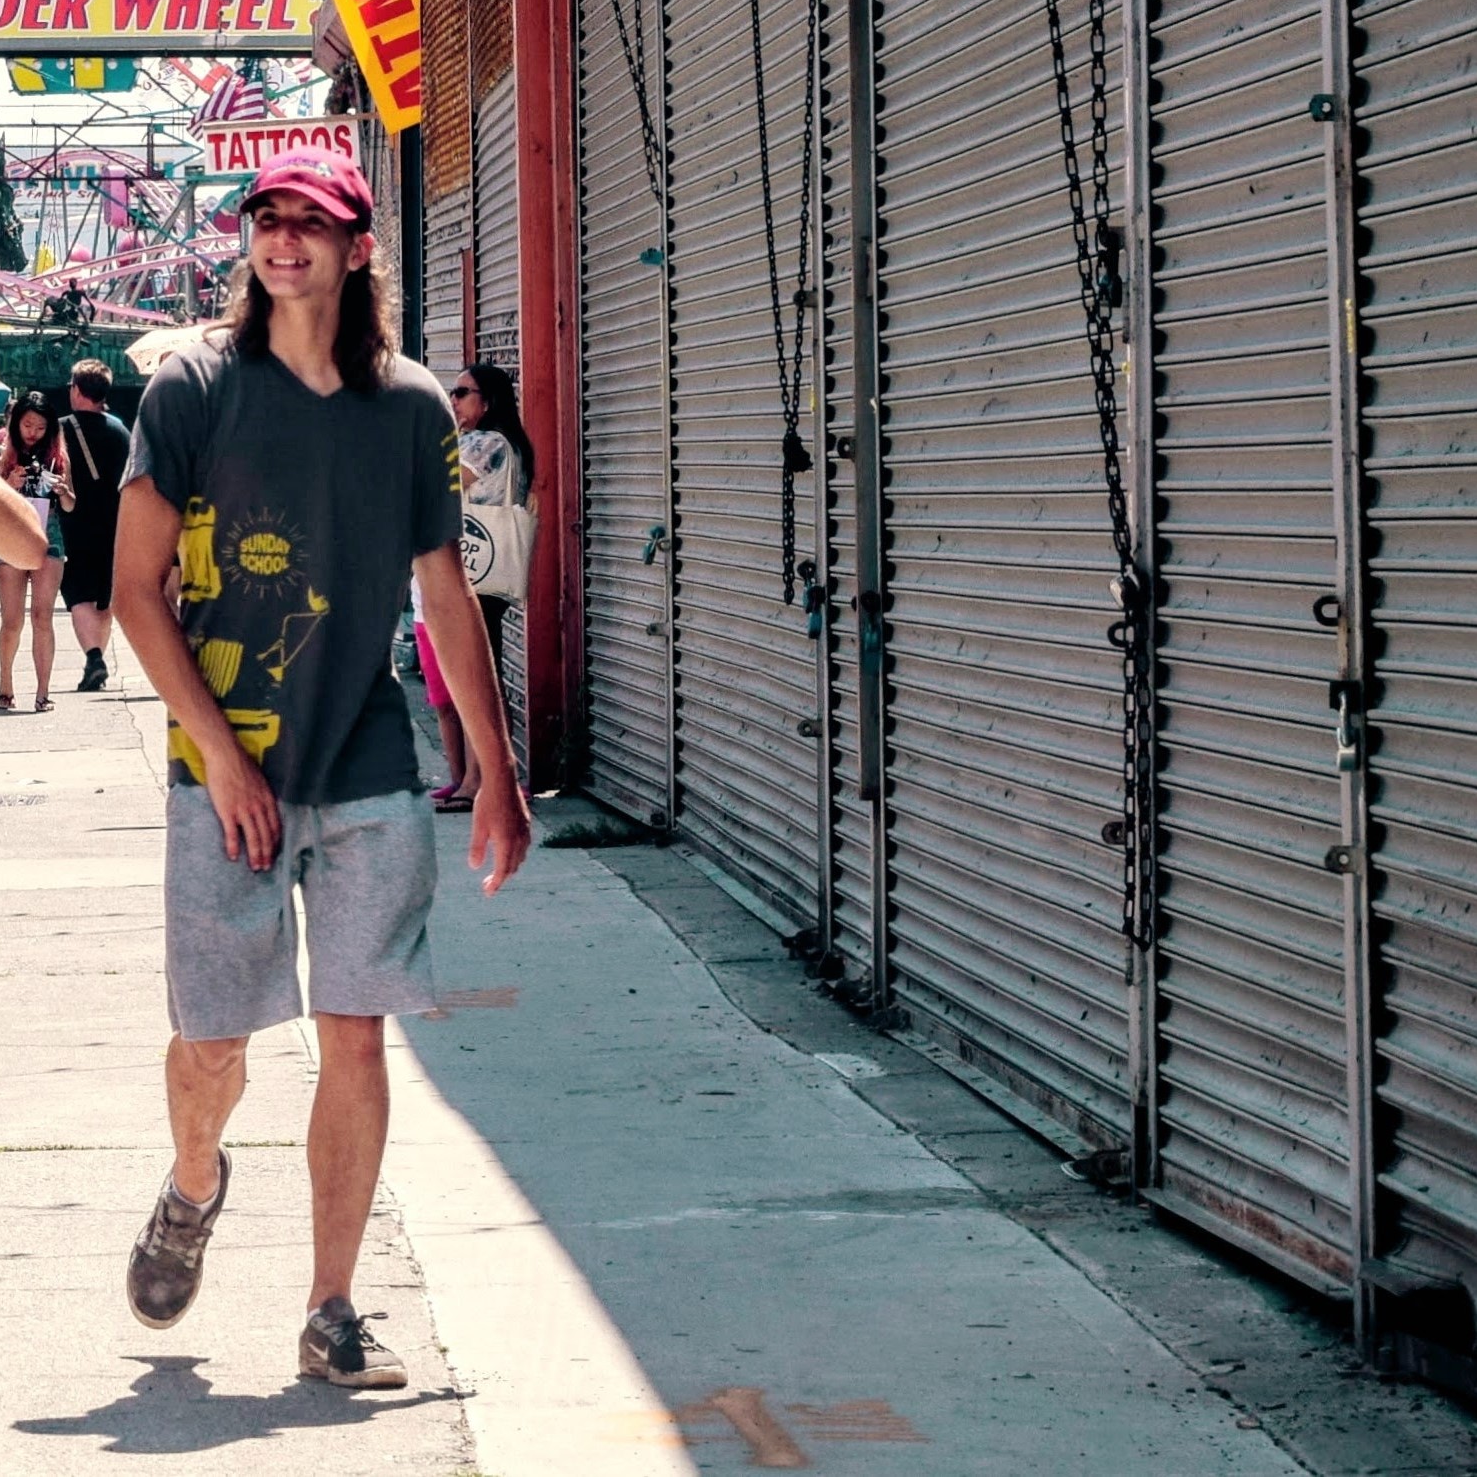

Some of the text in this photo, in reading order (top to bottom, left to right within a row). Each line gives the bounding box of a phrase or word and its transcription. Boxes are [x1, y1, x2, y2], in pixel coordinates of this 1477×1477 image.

[207, 124, 353, 171] TATTOOS
[240, 533, 291, 554] SUNDAY
[239, 553, 291, 575] SCHOOL
